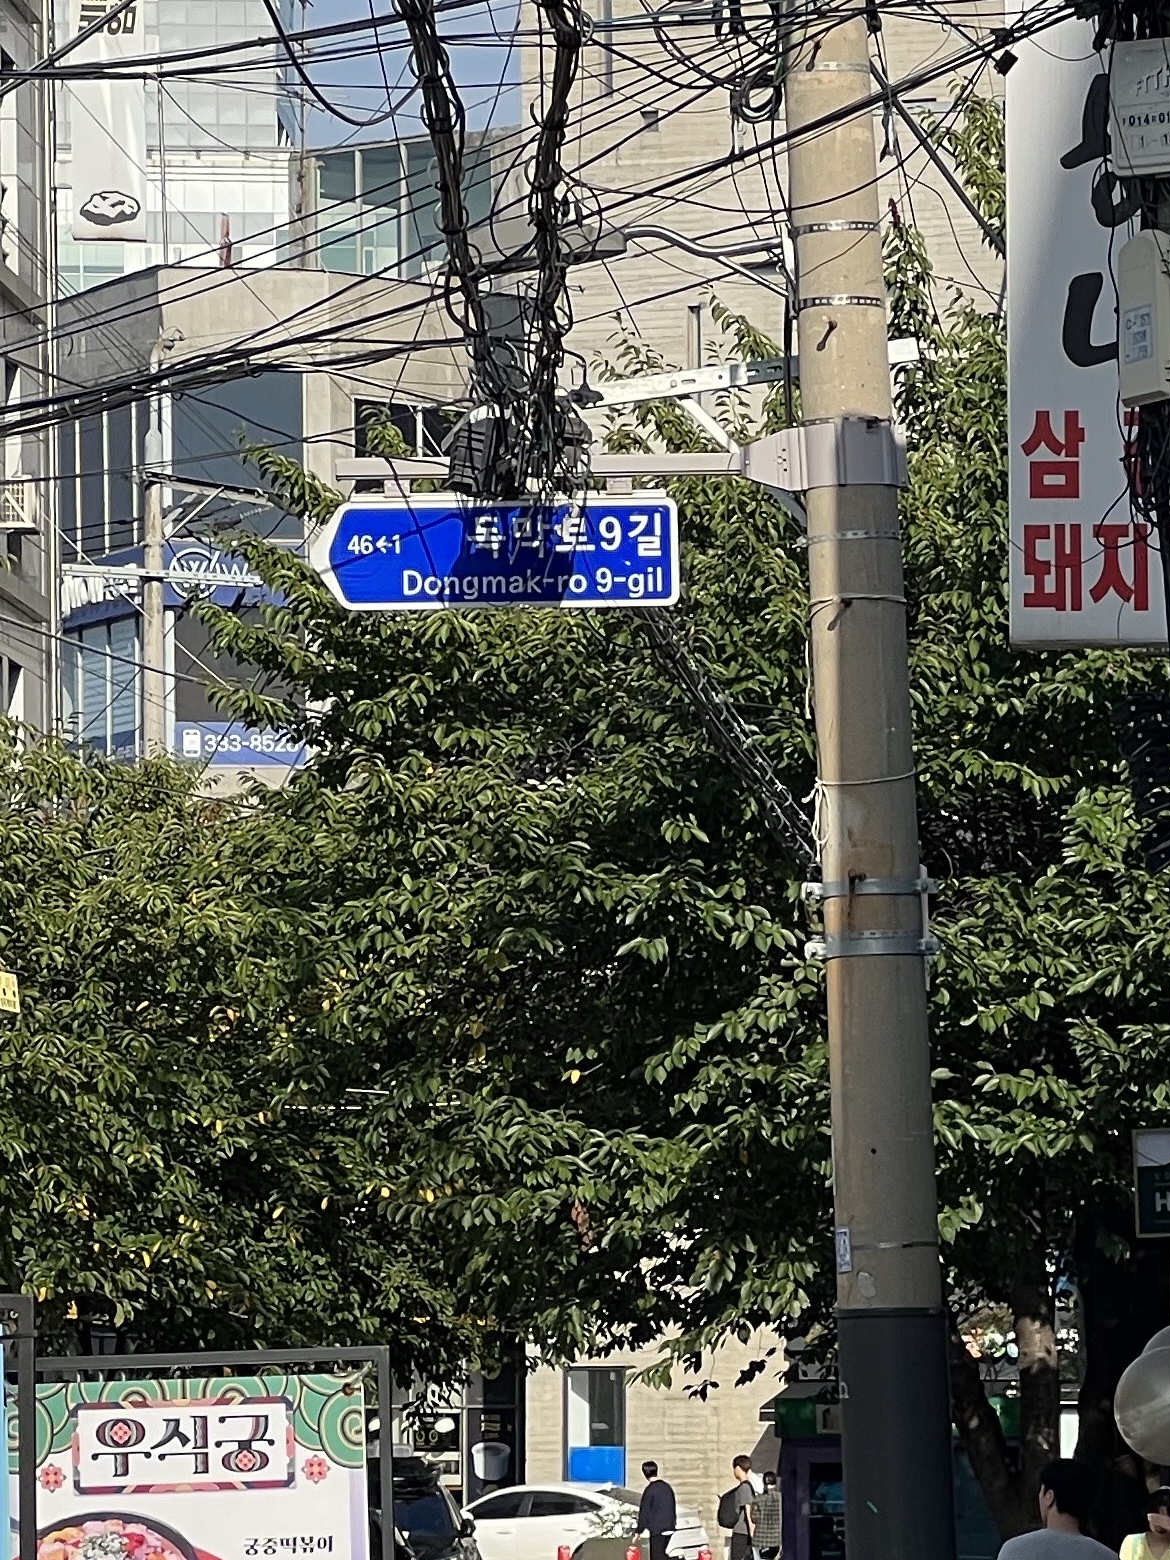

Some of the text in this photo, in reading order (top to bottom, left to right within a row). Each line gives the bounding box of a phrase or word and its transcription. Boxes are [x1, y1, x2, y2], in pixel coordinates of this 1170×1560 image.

[403, 567, 662, 602] Dongmak-ro 9-gil
[91, 1414, 275, 1478] 우식궁
